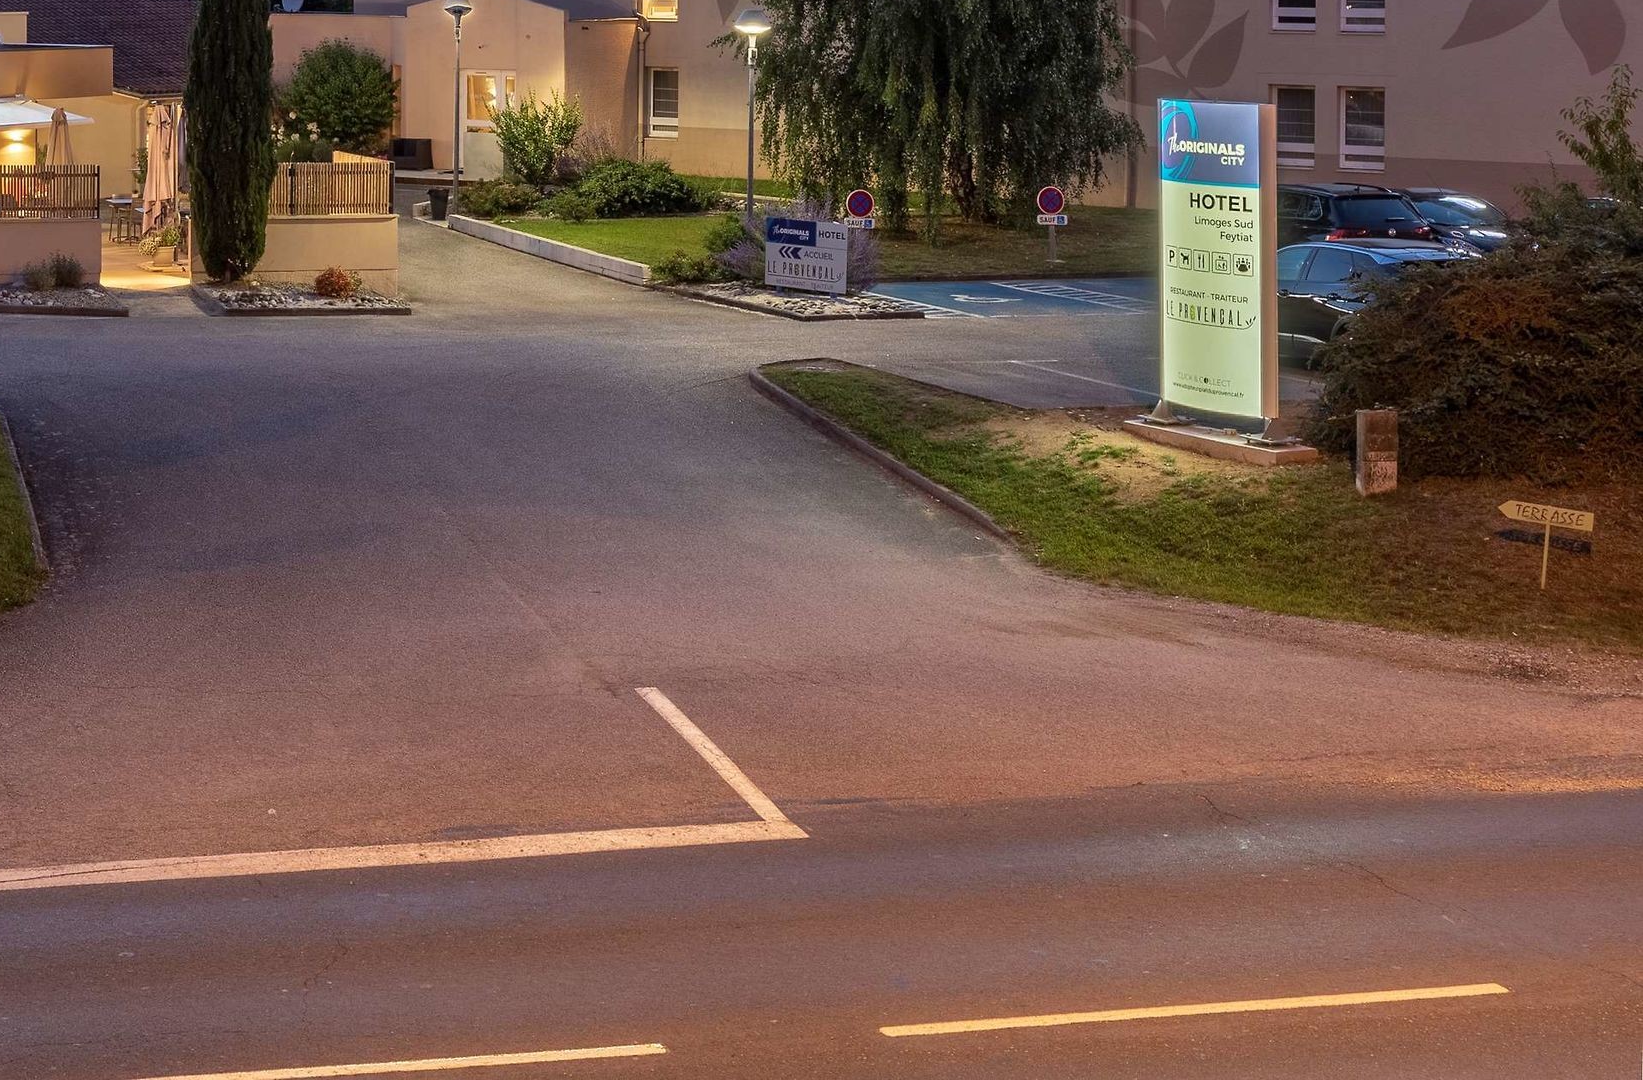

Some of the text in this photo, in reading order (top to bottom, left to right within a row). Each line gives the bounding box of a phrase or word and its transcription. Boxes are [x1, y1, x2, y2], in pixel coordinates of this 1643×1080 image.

[1220, 156, 1244, 166] CITY
[1190, 192, 1252, 212] HOTEL
[1195, 216, 1253, 229] Limoges Sud
[819, 230, 846, 240] HOTEL
[1220, 231, 1253, 242] Feytiat
[804, 250, 834, 260] ACCUEIL
[768, 260, 777, 273] LE
[1170, 287, 1205, 299] RESTAURANT
[1211, 293, 1248, 304] TRAITEUR
[1166, 300, 1174, 316] LE
[1199, 377, 1231, 387] COLLECT
[1515, 504, 1585, 526] TERRASSE
